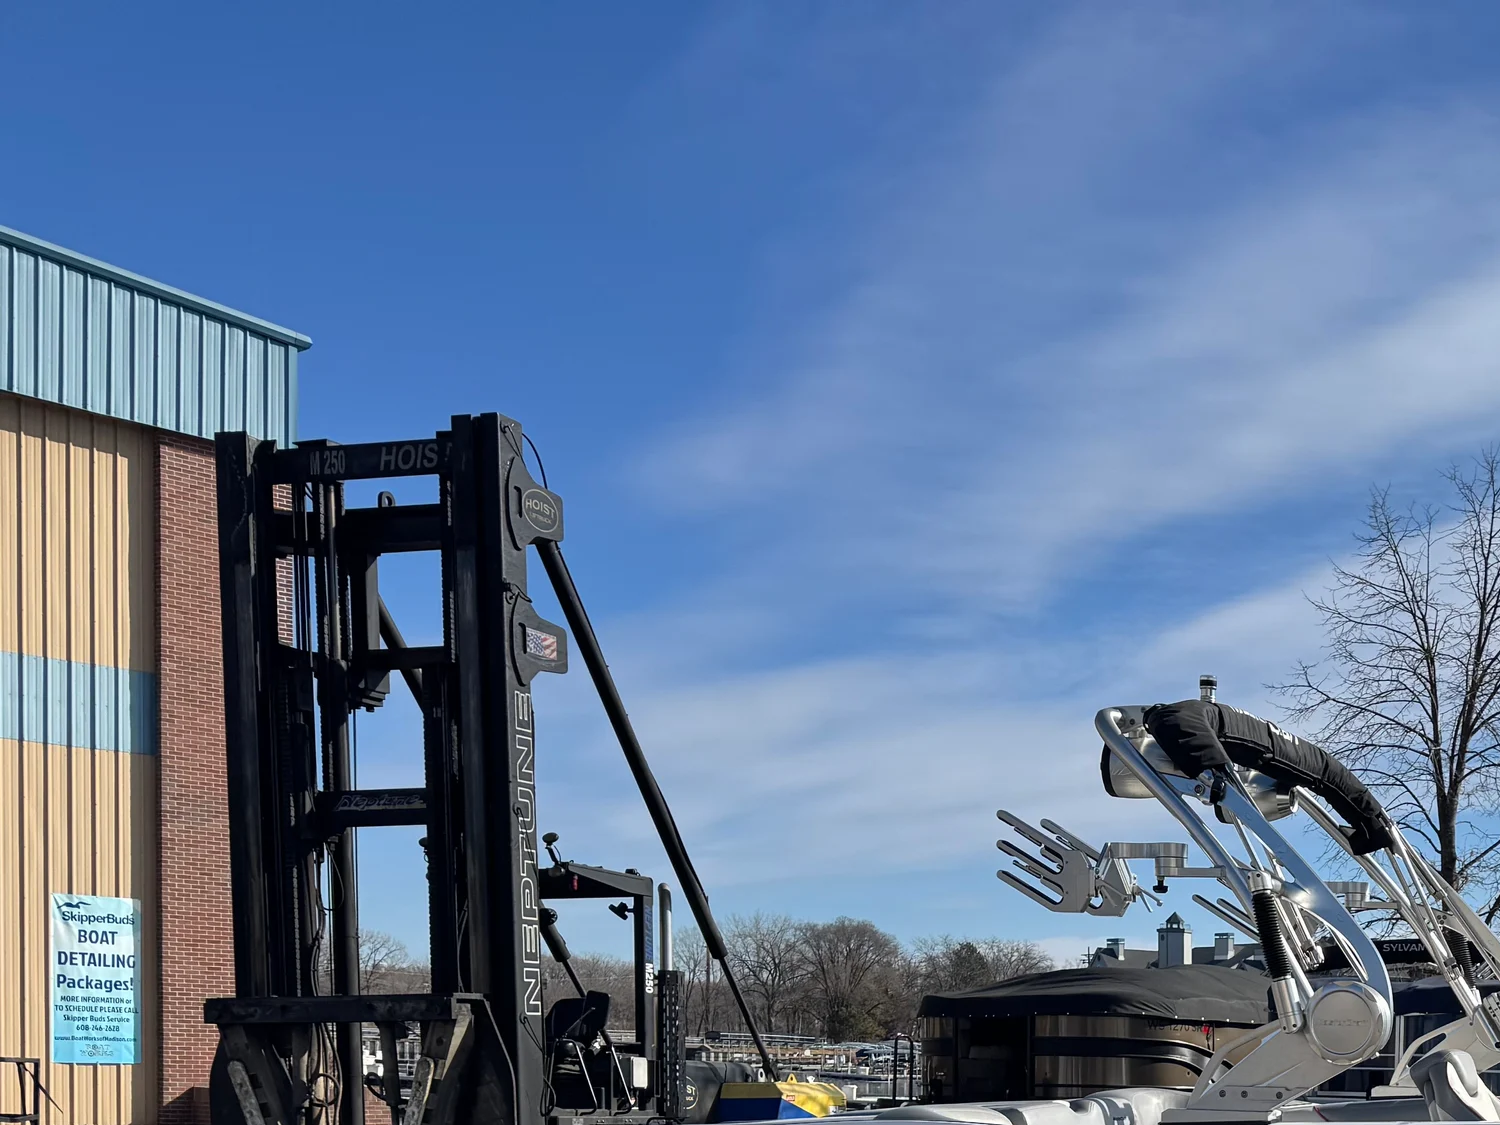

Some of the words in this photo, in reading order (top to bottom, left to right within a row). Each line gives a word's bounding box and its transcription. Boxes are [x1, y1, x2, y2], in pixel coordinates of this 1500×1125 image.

[309, 453, 320, 475] M
[323, 450, 346, 475] 250
[379, 441, 453, 472] HOIS
[525, 498, 555, 518] HOIST
[514, 690, 543, 1016] NEPTUNE
[78, 929, 118, 945] BOAT
[57, 951, 136, 969] DETAILING
[56, 974, 134, 993] Packages!
[645, 963, 654, 994] M250
[60, 995, 80, 1003] MORE
[81, 996, 125, 1004] INFORMATION
[63, 1014, 88, 1022] Skipper
[65, 1005, 98, 1013] SCHEDULE
[76, 1024, 120, 1032] 608-246-2628
